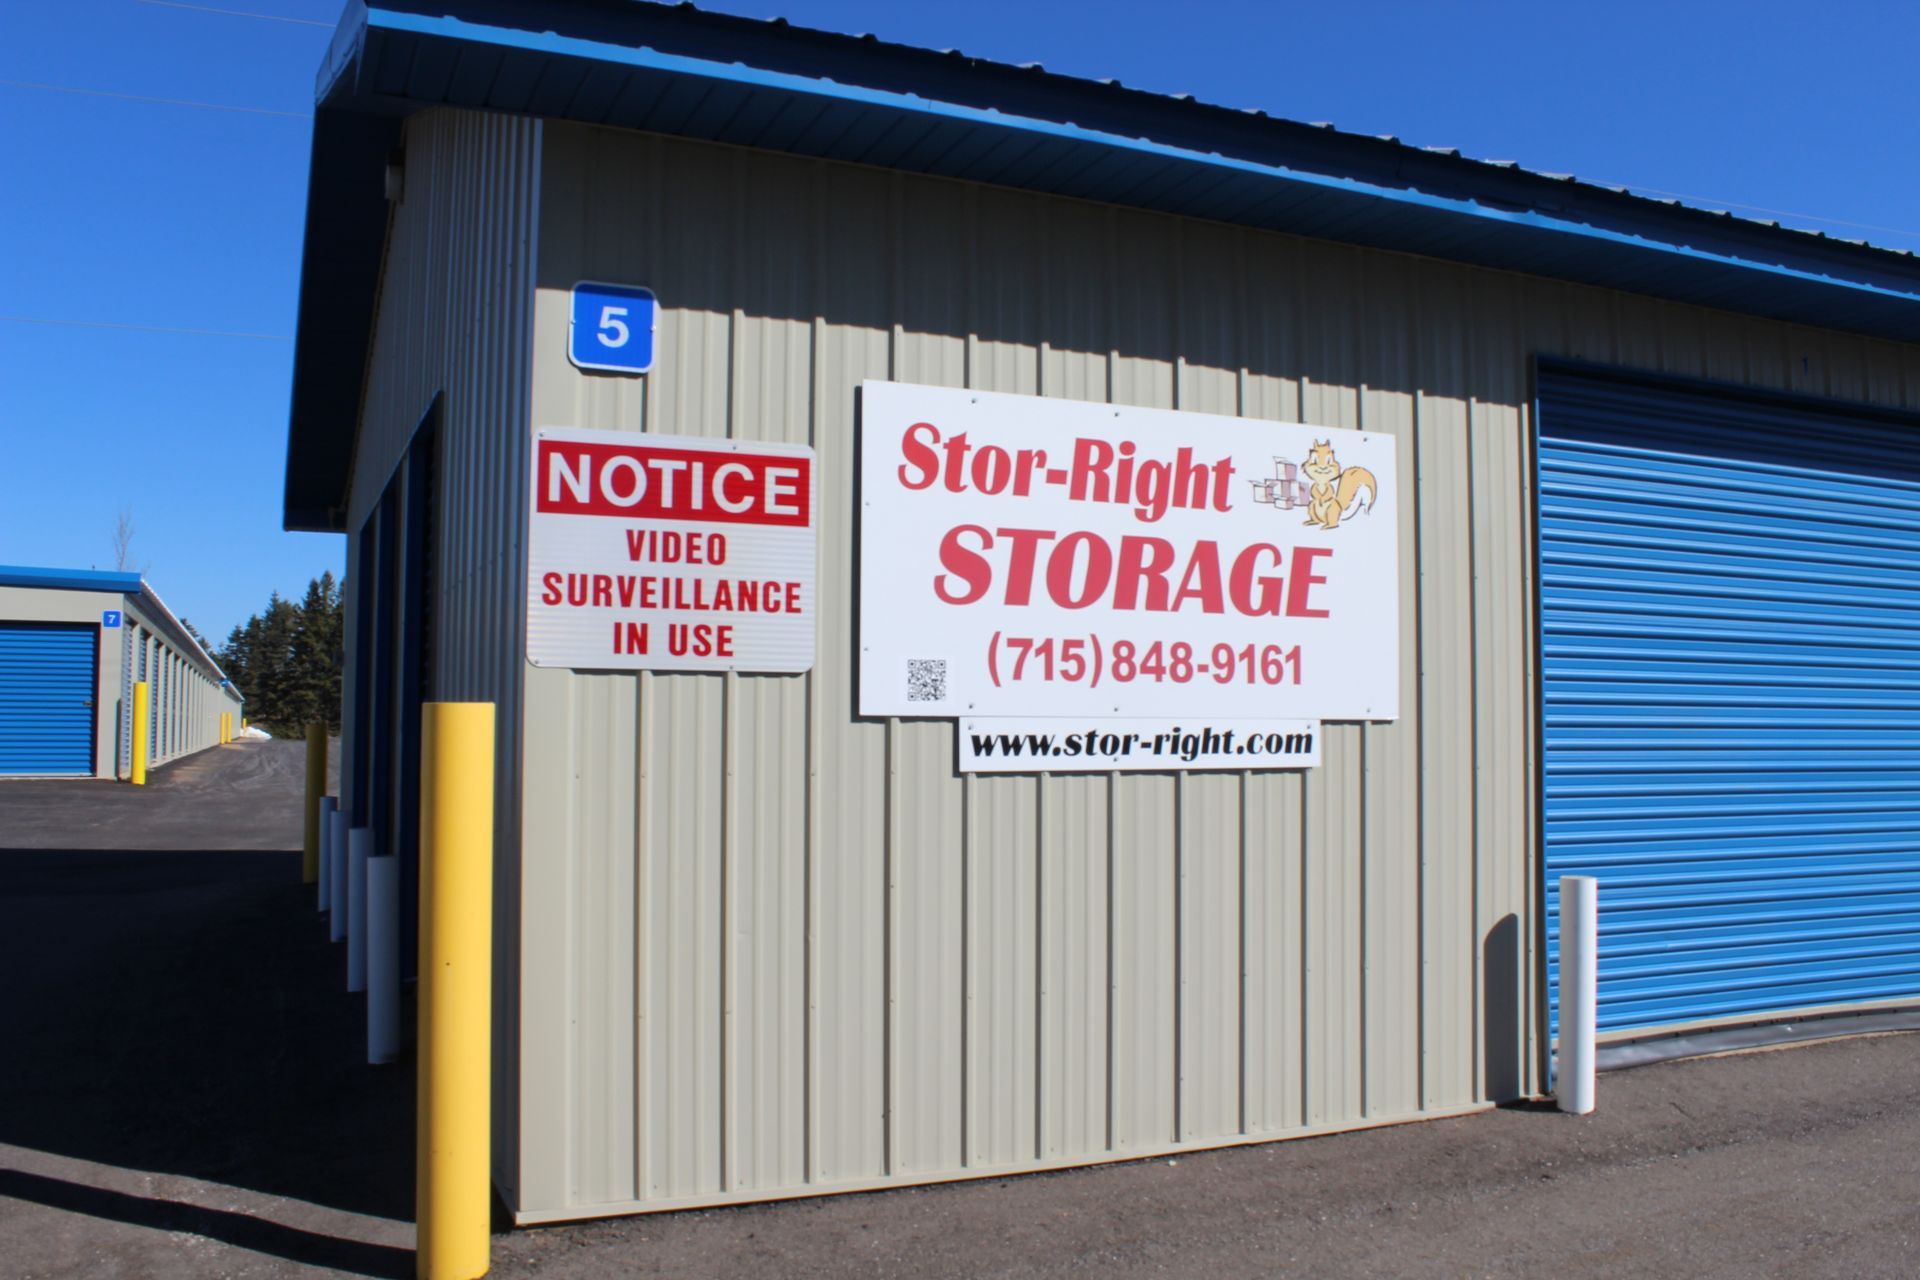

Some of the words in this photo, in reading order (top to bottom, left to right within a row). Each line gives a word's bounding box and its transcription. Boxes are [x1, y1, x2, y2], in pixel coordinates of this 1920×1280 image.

[597, 306, 629, 347] 5
[548, 452, 799, 515] NOTICE
[898, 422, 1236, 522] Stor-Right
[626, 529, 726, 565] VIDEO
[934, 524, 1333, 618] STORAGE
[542, 572, 802, 613] SURVEILLANCE
[108, 614, 116, 624] 7
[614, 622, 648, 655] IN
[668, 624, 734, 657] USE
[988, 631, 1302, 688] (715)848-9161
[971, 727, 1313, 762] www.stor-right.com
